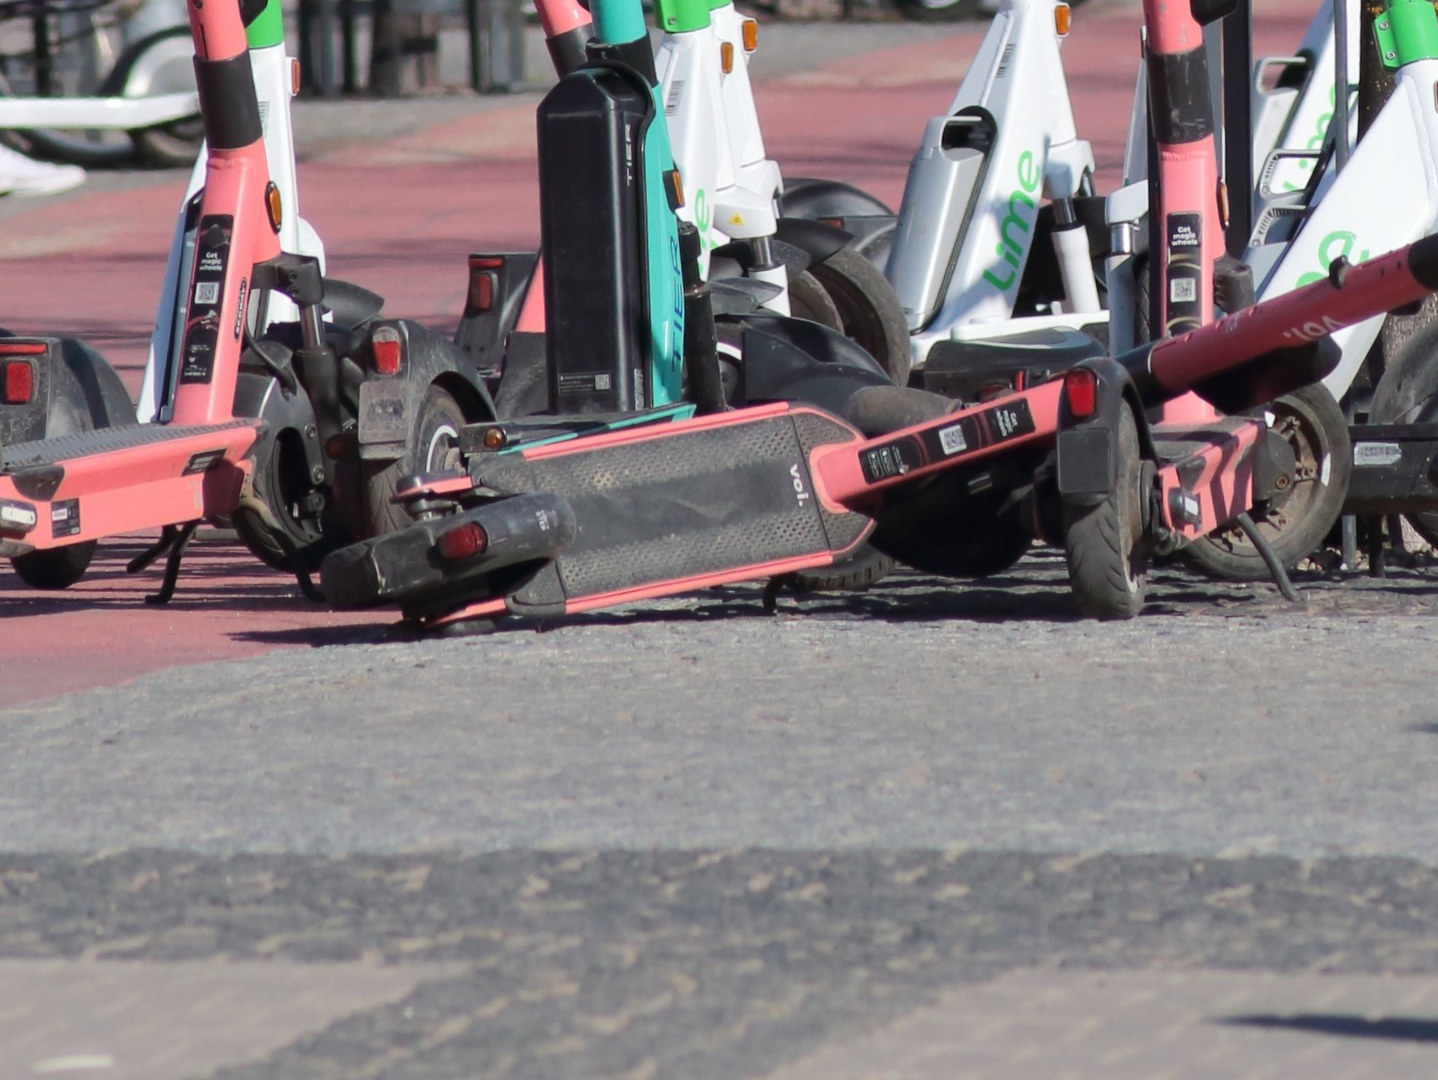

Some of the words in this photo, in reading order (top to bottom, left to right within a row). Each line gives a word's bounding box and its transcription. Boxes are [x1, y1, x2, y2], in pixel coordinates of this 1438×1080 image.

[624, 123, 633, 187] TIER
[982, 149, 1041, 291] Lime
[790, 464, 809, 507] voi.
